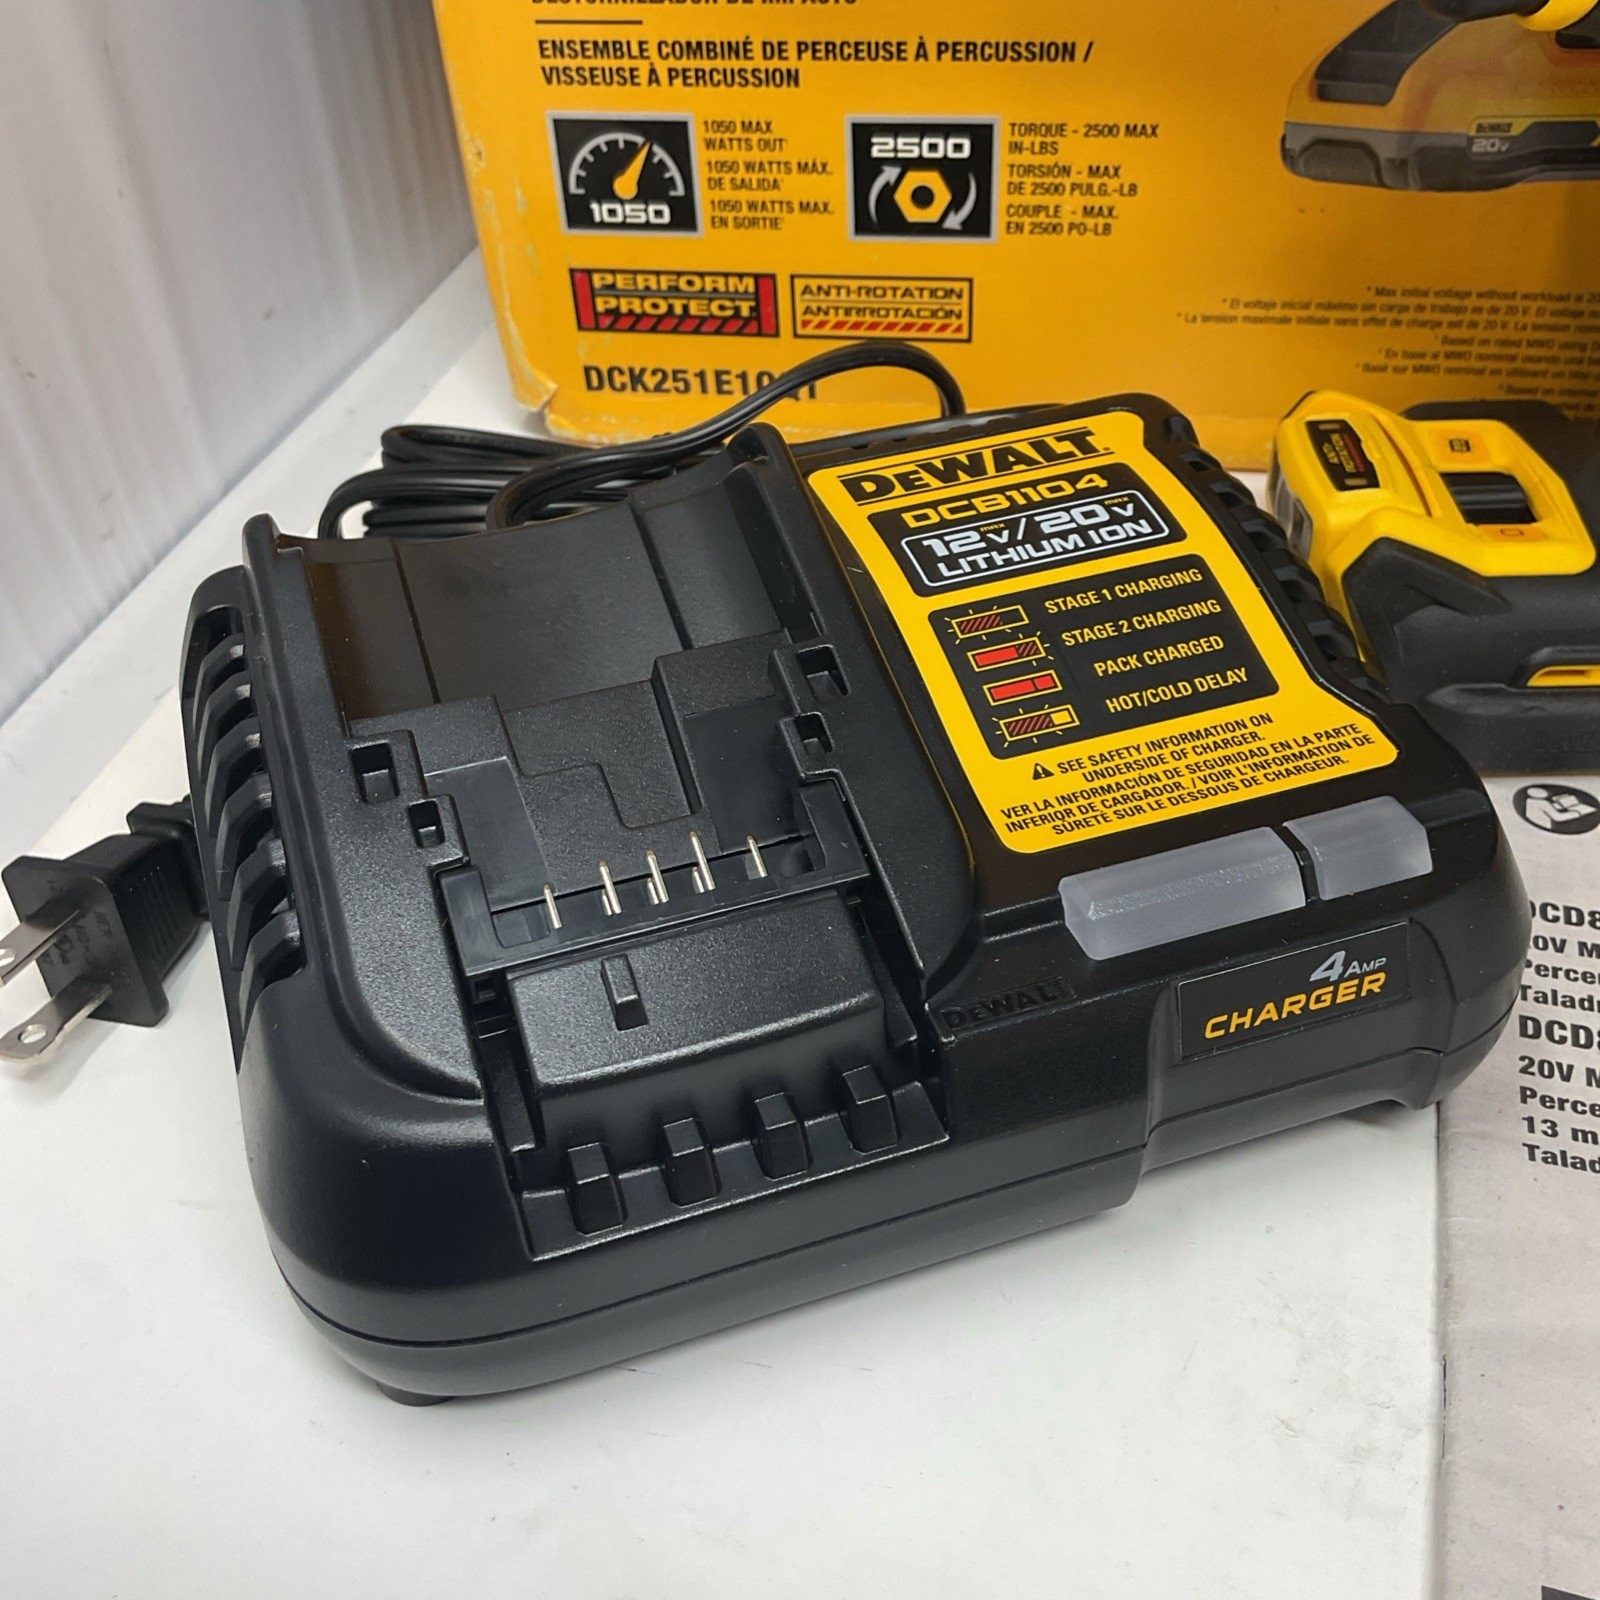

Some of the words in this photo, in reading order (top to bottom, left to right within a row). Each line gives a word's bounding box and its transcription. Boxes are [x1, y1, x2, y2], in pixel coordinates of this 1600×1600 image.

[537, 39, 650, 60] ENSEMBLE
[657, 35, 754, 61] COMBINÉ
[762, 41, 789, 61] DE
[797, 41, 908, 62] PERCEUSE
[914, 35, 929, 62] À
[936, 41, 1076, 62] PERCUSSION
[541, 66, 641, 87] VISSEUSE
[648, 62, 662, 87] À
[667, 67, 800, 88] PERCUSSION
[703, 120, 737, 134] 1050
[741, 120, 773, 134] MAX
[1008, 123, 1068, 138] TORQUE
[1083, 124, 1121, 138] 2500
[1124, 124, 1159, 138] MAX
[703, 138, 753, 151] WATTS
[870, 137, 971, 159] 2500
[1008, 141, 1059, 156] IN-LBS
[707, 160, 740, 174] 1050
[743, 160, 793, 175] WATTS
[1008, 162, 1072, 179] TORSIÓN
[1087, 165, 1122, 179] MAX
[707, 177, 726, 191] DE
[1007, 182, 1026, 196] DE
[1030, 182, 1066, 196] 2500
[589, 202, 671, 225] 1050
[710, 200, 742, 213] 1050
[746, 200, 795, 214] WATTS
[1006, 204, 1062, 219] COUPLE
[1082, 205, 1119, 219] MAX.
[710, 216, 729, 230] EN
[1006, 221, 1025, 235] EN
[1029, 222, 1064, 236] 2500
[1067, 222, 1112, 236] PO-LB
[592, 271, 756, 295] PERFORM
[801, 284, 963, 300] ANTI-ROTATION
[595, 297, 756, 319] PROTECT
[901, 473, 1109, 528] DCB1104
[937, 533, 1086, 578] LITHIUM
[1087, 518, 1153, 545] ION
[1044, 590, 1101, 614] STAGE
[1102, 588, 1112, 601] 1
[1114, 568, 1203, 598] CHARGING
[1061, 622, 1119, 646] STAGE
[1118, 619, 1131, 634] 2
[1132, 599, 1222, 630] CHARGING
[1093, 654, 1143, 677] PACK
[1143, 635, 1224, 665] CHARGED
[1105, 681, 1193, 713] HOT/COLD
[1193, 667, 1248, 692] DELAY
[1057, 758, 1087, 774] SEE
[1087, 744, 1142, 768] SAFETY
[1145, 719, 1248, 752] INFORMATION
[1249, 712, 1274, 727] ON
[1083, 753, 1170, 783] UNDERSIDE
[1171, 748, 1190, 762] OF
[1193, 731, 1266, 756] CHARGER.
[1000, 805, 1033, 819] VER
[1035, 799, 1055, 813] LA
[1055, 773, 1162, 806] INFORMACIÓN
[1162, 767, 1185, 780] DE
[1188, 746, 1271, 774] SEGURIDAD
[1270, 740, 1294, 754] EN
[1293, 735, 1314, 748] LA
[1314, 723, 1362, 743] PARTE
[1005, 807, 1077, 833] INFERIOR
[1077, 802, 1100, 816] DE
[1101, 781, 1190, 809] CARGADOR.
[1200, 769, 1236, 785] VOIR
[1235, 740, 1354, 776] L'INFORMATION
[1351, 734, 1376, 748] DE
[1051, 809, 1113, 836] SÛRETÉ
[1113, 805, 1147, 820] SUR
[1146, 799, 1167, 812] LE
[1167, 780, 1240, 806] DESSOUS
[1239, 777, 1264, 789] DE
[1263, 755, 1349, 783] CHARGEUR.
[1205, 971, 1386, 1039] CHARGER
[1518, 1055, 1574, 1083] 20V
[1522, 1115, 1559, 1138] 13
